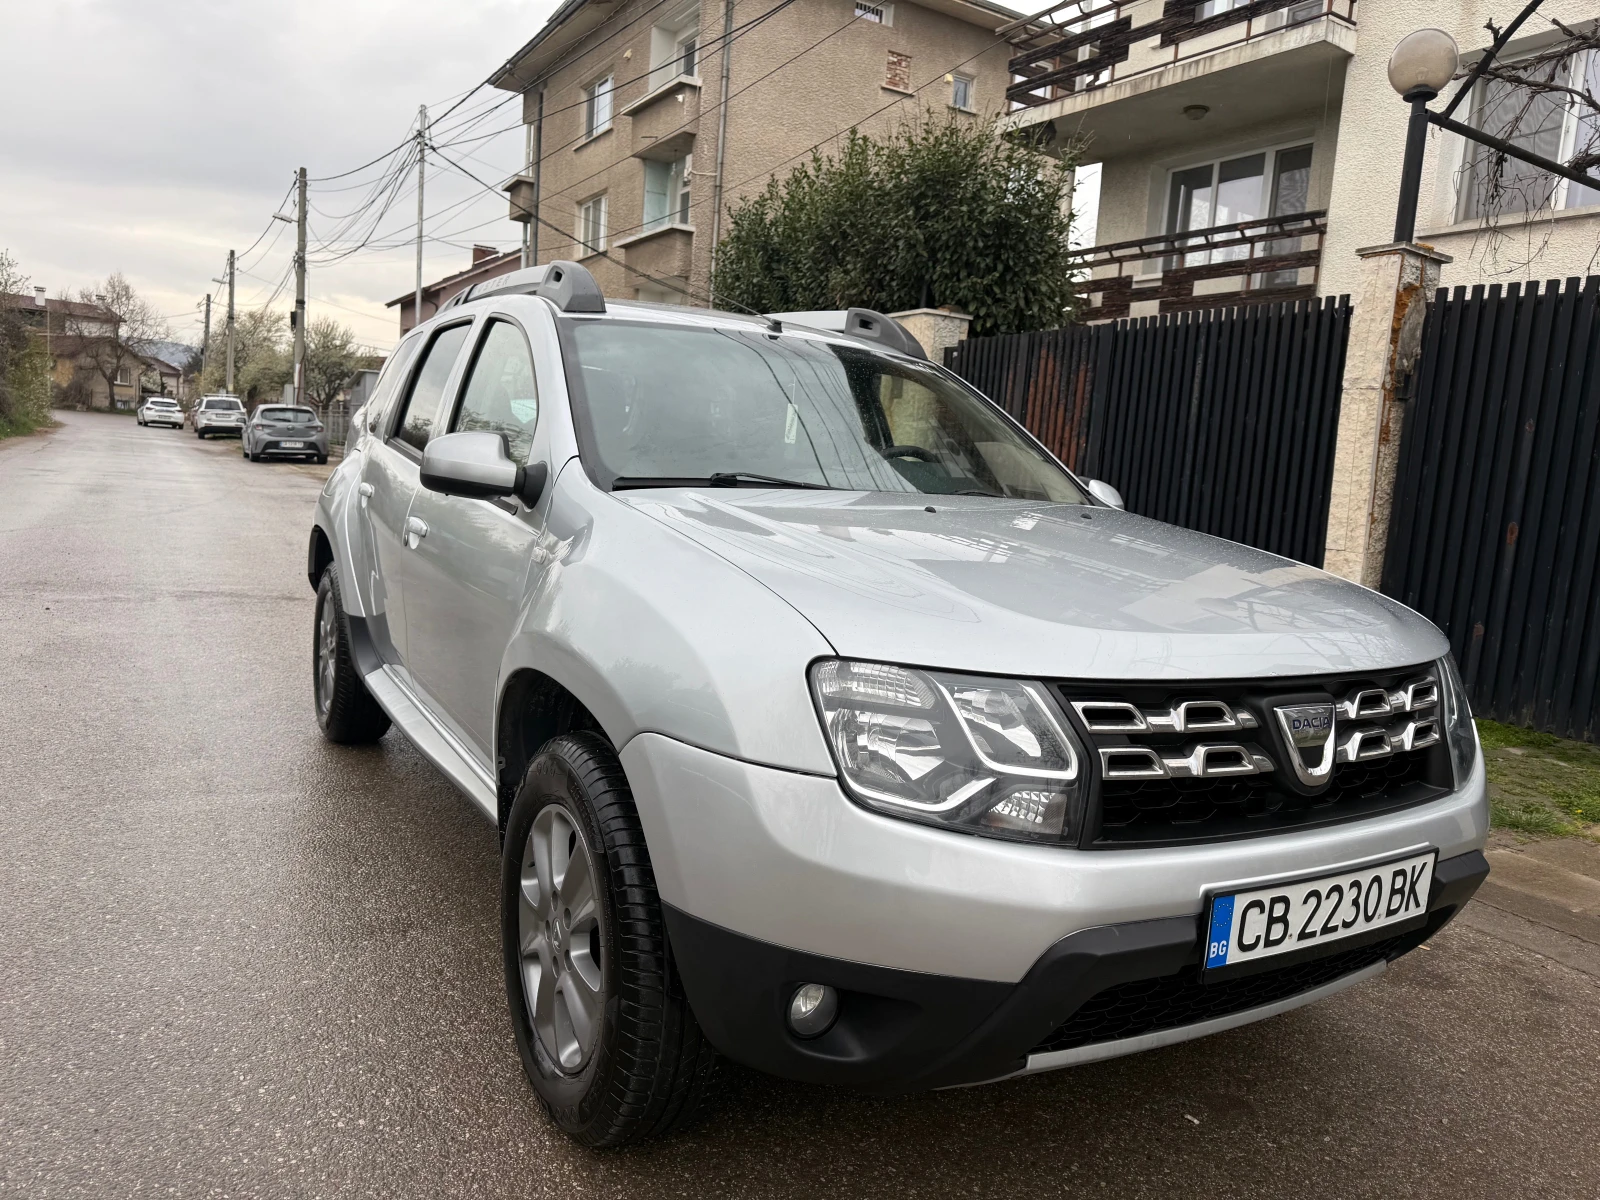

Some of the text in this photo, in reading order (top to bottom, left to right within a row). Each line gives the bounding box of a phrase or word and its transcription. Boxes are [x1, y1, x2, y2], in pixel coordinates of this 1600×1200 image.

[1293, 717, 1331, 729] DACIA
[1297, 874, 1383, 941] 2230
[1210, 940, 1227, 958] BG
